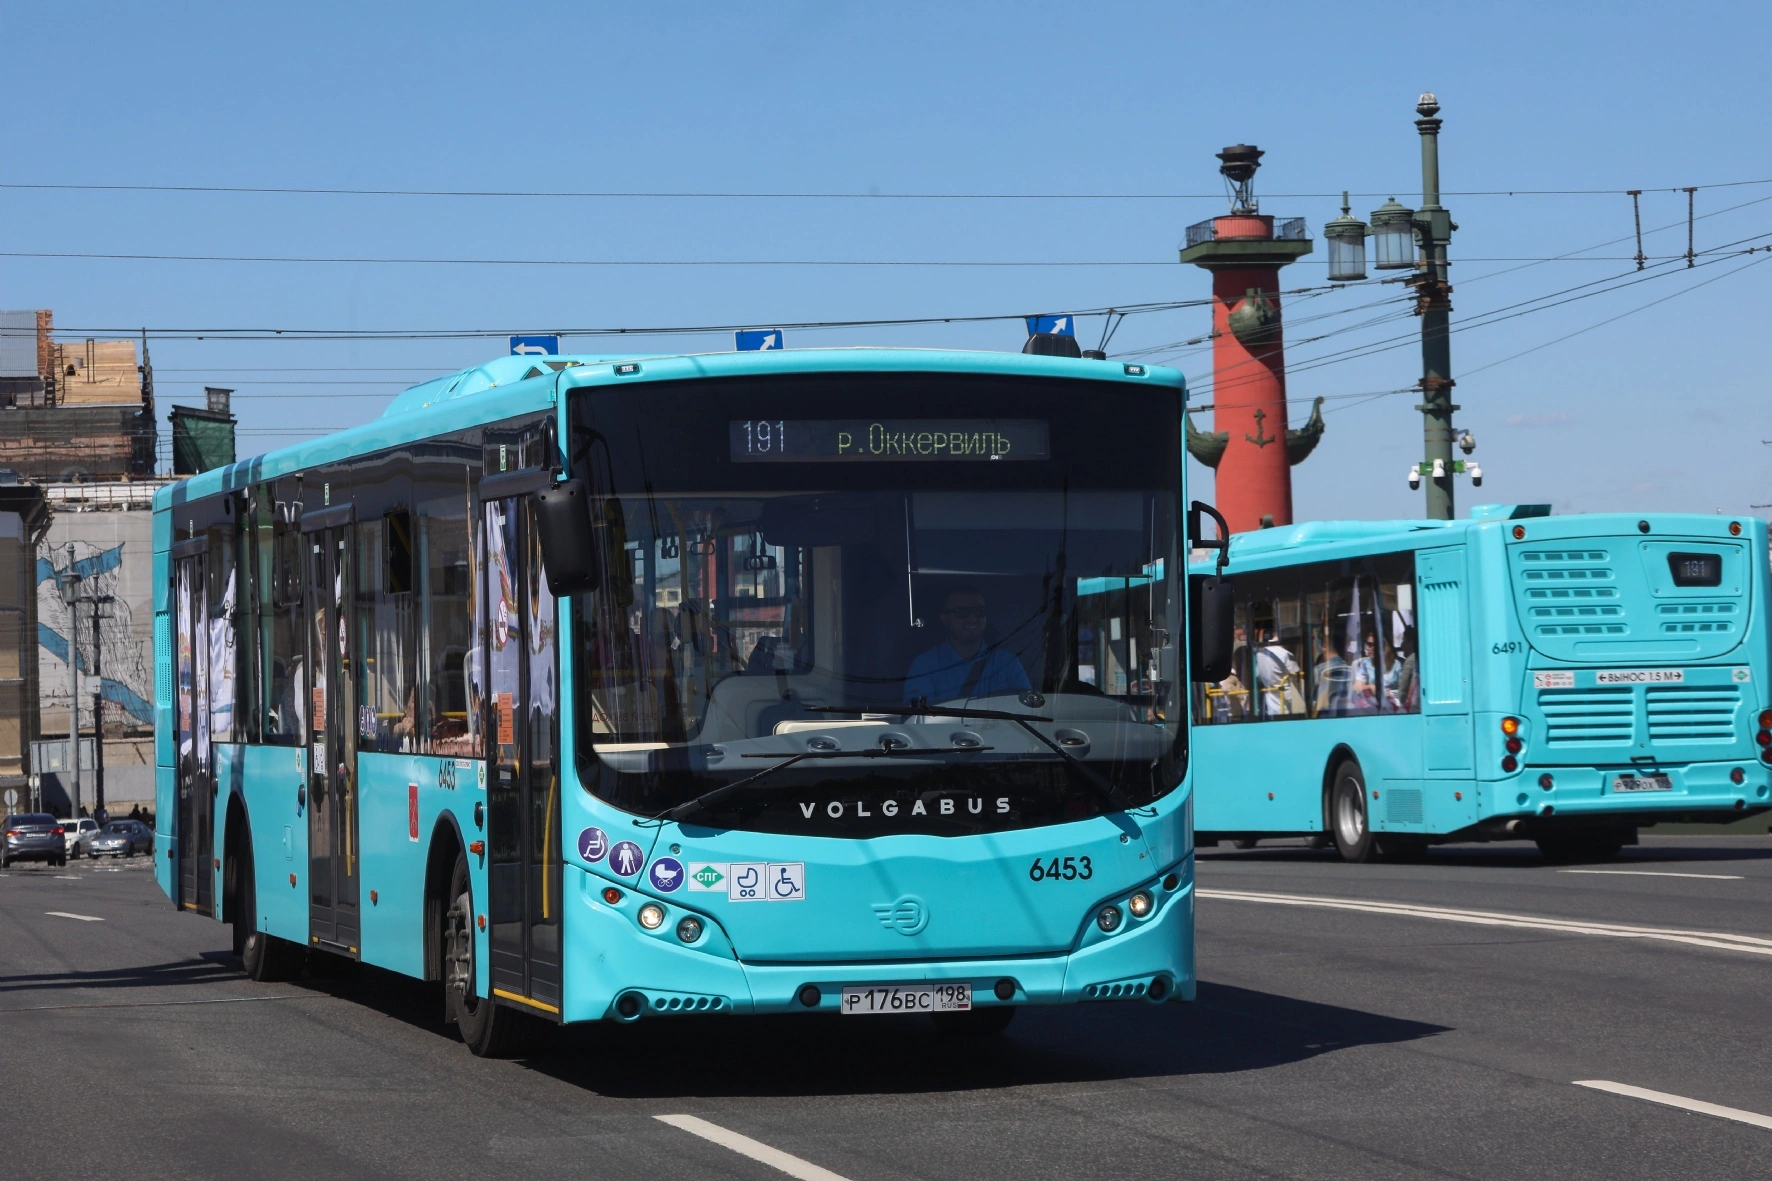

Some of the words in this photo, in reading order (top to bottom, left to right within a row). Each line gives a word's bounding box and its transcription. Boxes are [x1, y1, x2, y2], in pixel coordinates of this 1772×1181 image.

[743, 420, 784, 452] 191
[1684, 560, 1705, 576] 191
[1492, 641, 1522, 655] 6491
[1607, 672, 1646, 683] ВЫНОС
[1649, 672, 1662, 682] 1.5
[438, 759, 456, 790] 6453
[800, 798, 1011, 819] VOLGABUS
[696, 872, 718, 881] СПГ
[1029, 855, 1093, 882] 6453
[849, 989, 931, 1011] Р176ВС
[935, 985, 966, 1002] 198
